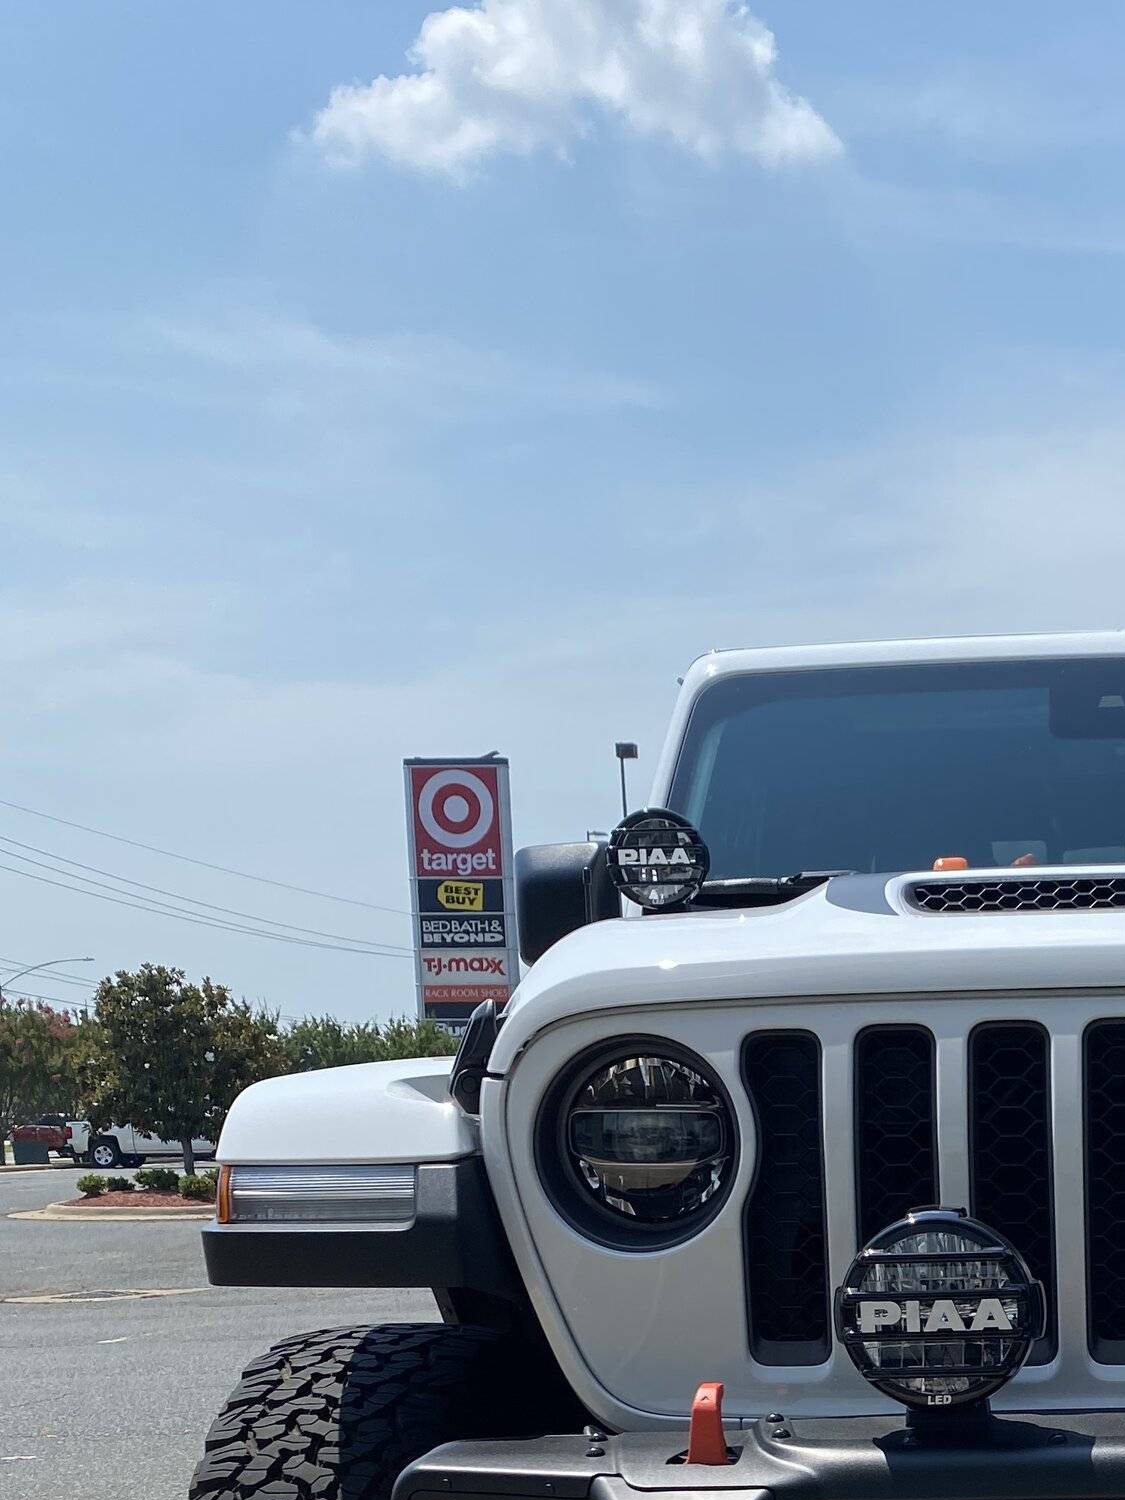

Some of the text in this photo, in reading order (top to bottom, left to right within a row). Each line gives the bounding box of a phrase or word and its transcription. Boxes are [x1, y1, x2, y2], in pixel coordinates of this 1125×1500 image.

[421, 848, 496, 875] target
[618, 848, 690, 865] PIAA
[444, 885, 481, 896] BEST
[445, 896, 477, 906] BUY
[422, 920, 503, 932] BED BATH &
[423, 933, 504, 943] BEYOND
[425, 988, 507, 998] RACK ROOM SHOES
[860, 1299, 1013, 1333] PIAA
[927, 1395, 952, 1405] LED
